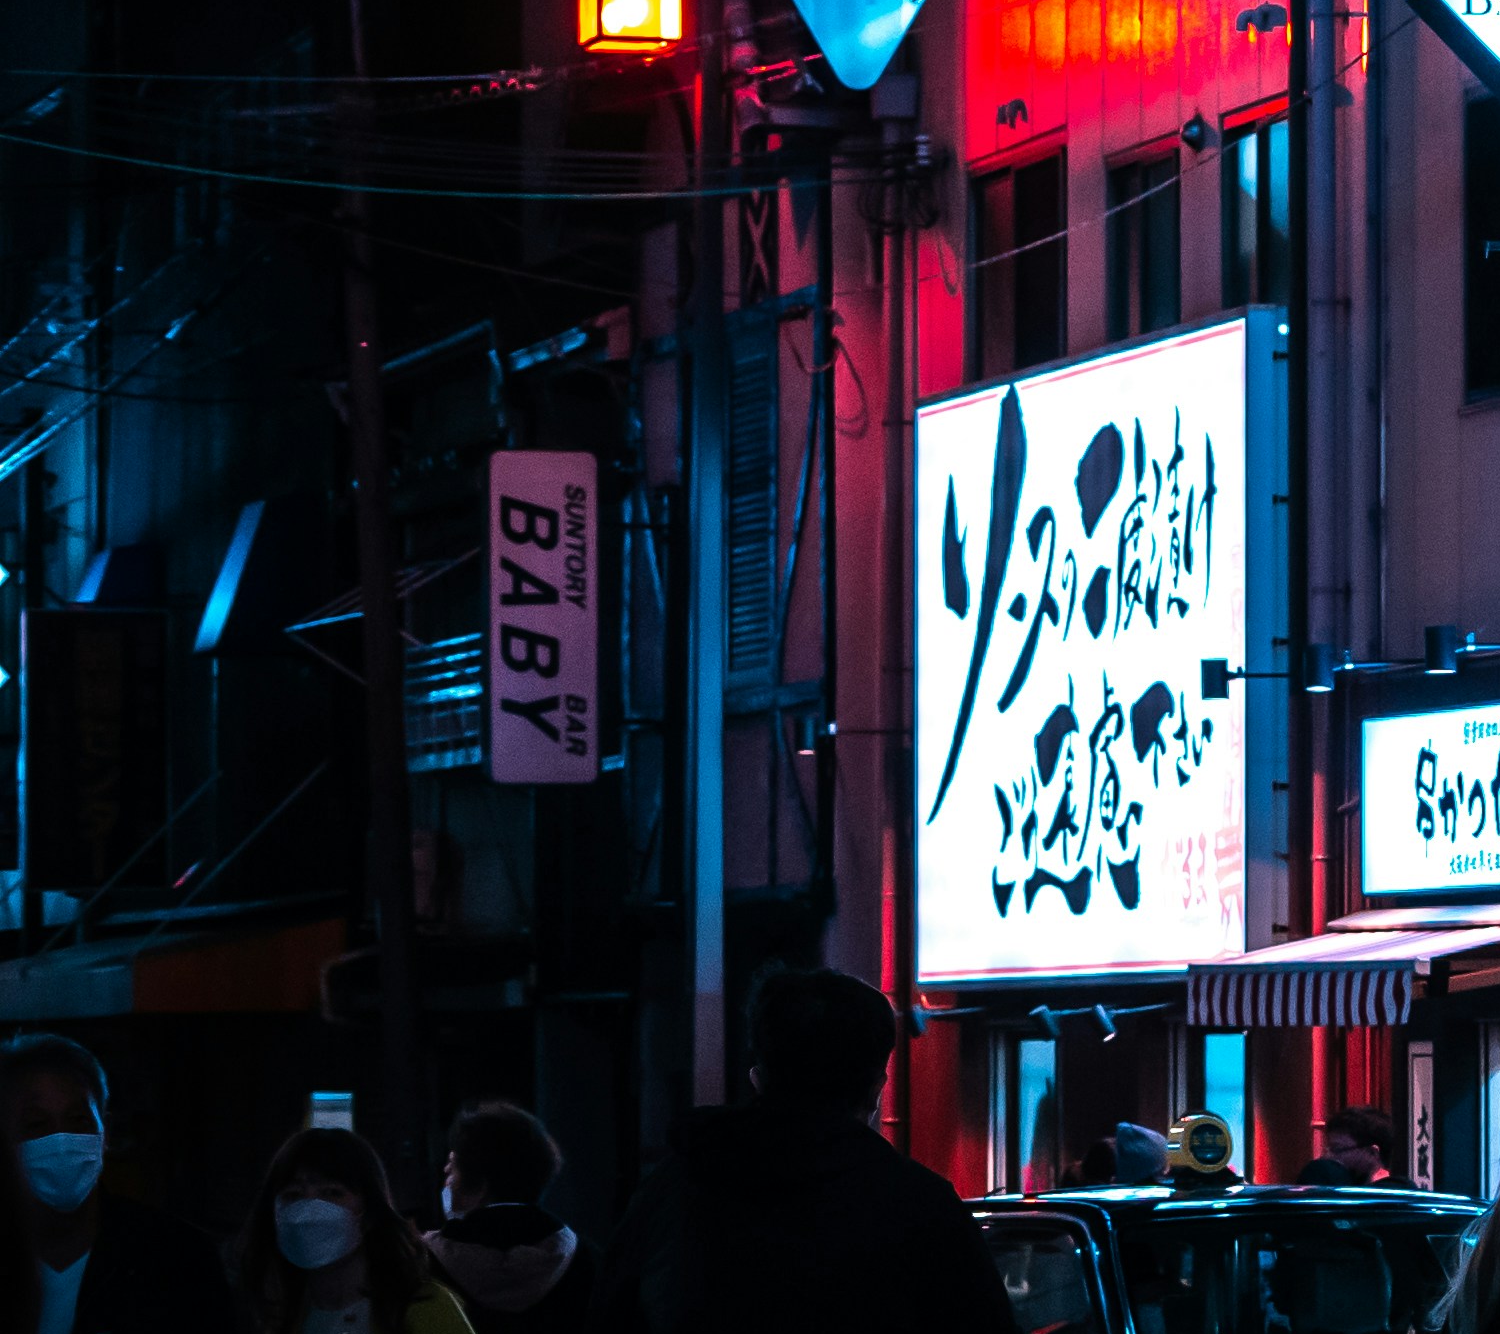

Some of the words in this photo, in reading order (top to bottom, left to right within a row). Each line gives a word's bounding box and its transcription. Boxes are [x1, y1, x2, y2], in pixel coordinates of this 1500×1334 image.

[564, 483, 588, 609] SUNTORY
[500, 494, 560, 743] BABY
[565, 693, 588, 758] BAR
